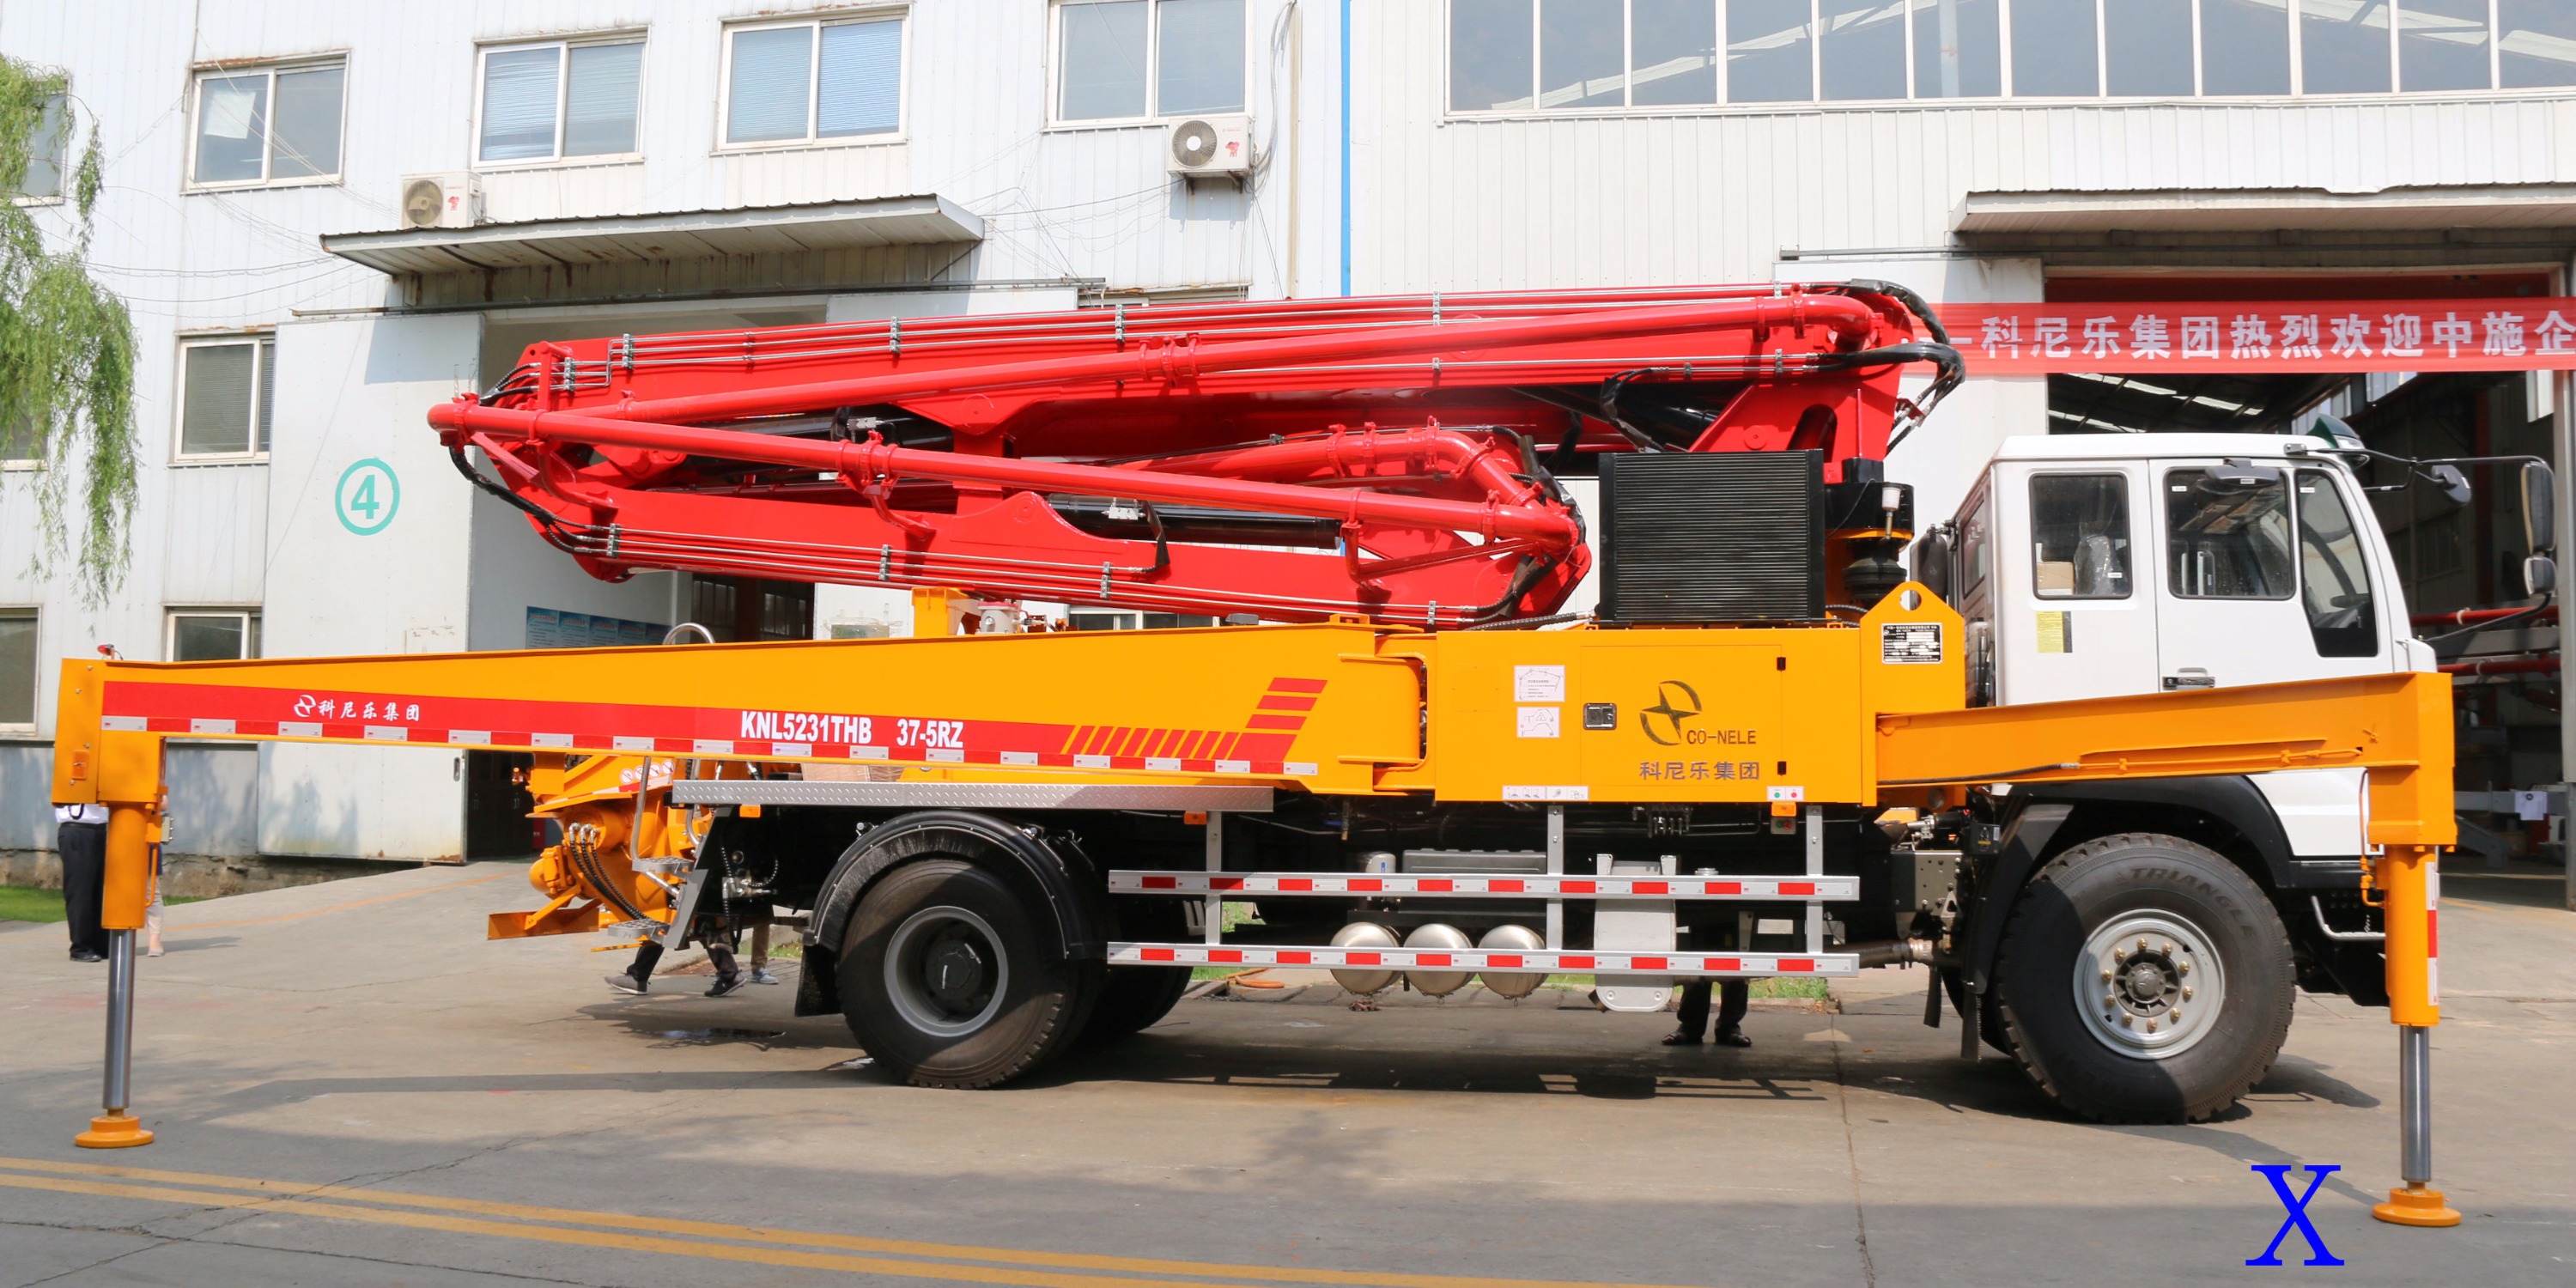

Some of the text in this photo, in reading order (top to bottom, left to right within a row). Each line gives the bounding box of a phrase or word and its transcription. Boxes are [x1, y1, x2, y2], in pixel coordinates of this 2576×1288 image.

[350, 474, 380, 519] 4
[318, 698, 420, 722] 科尼乐集团
[741, 710, 963, 749] KNL5231THB 37-5RZ
[1686, 729, 1757, 744] CO-NELE
[1639, 761, 1760, 781] 科尼乐集团
[2131, 867, 2255, 938] TRIANGLE
